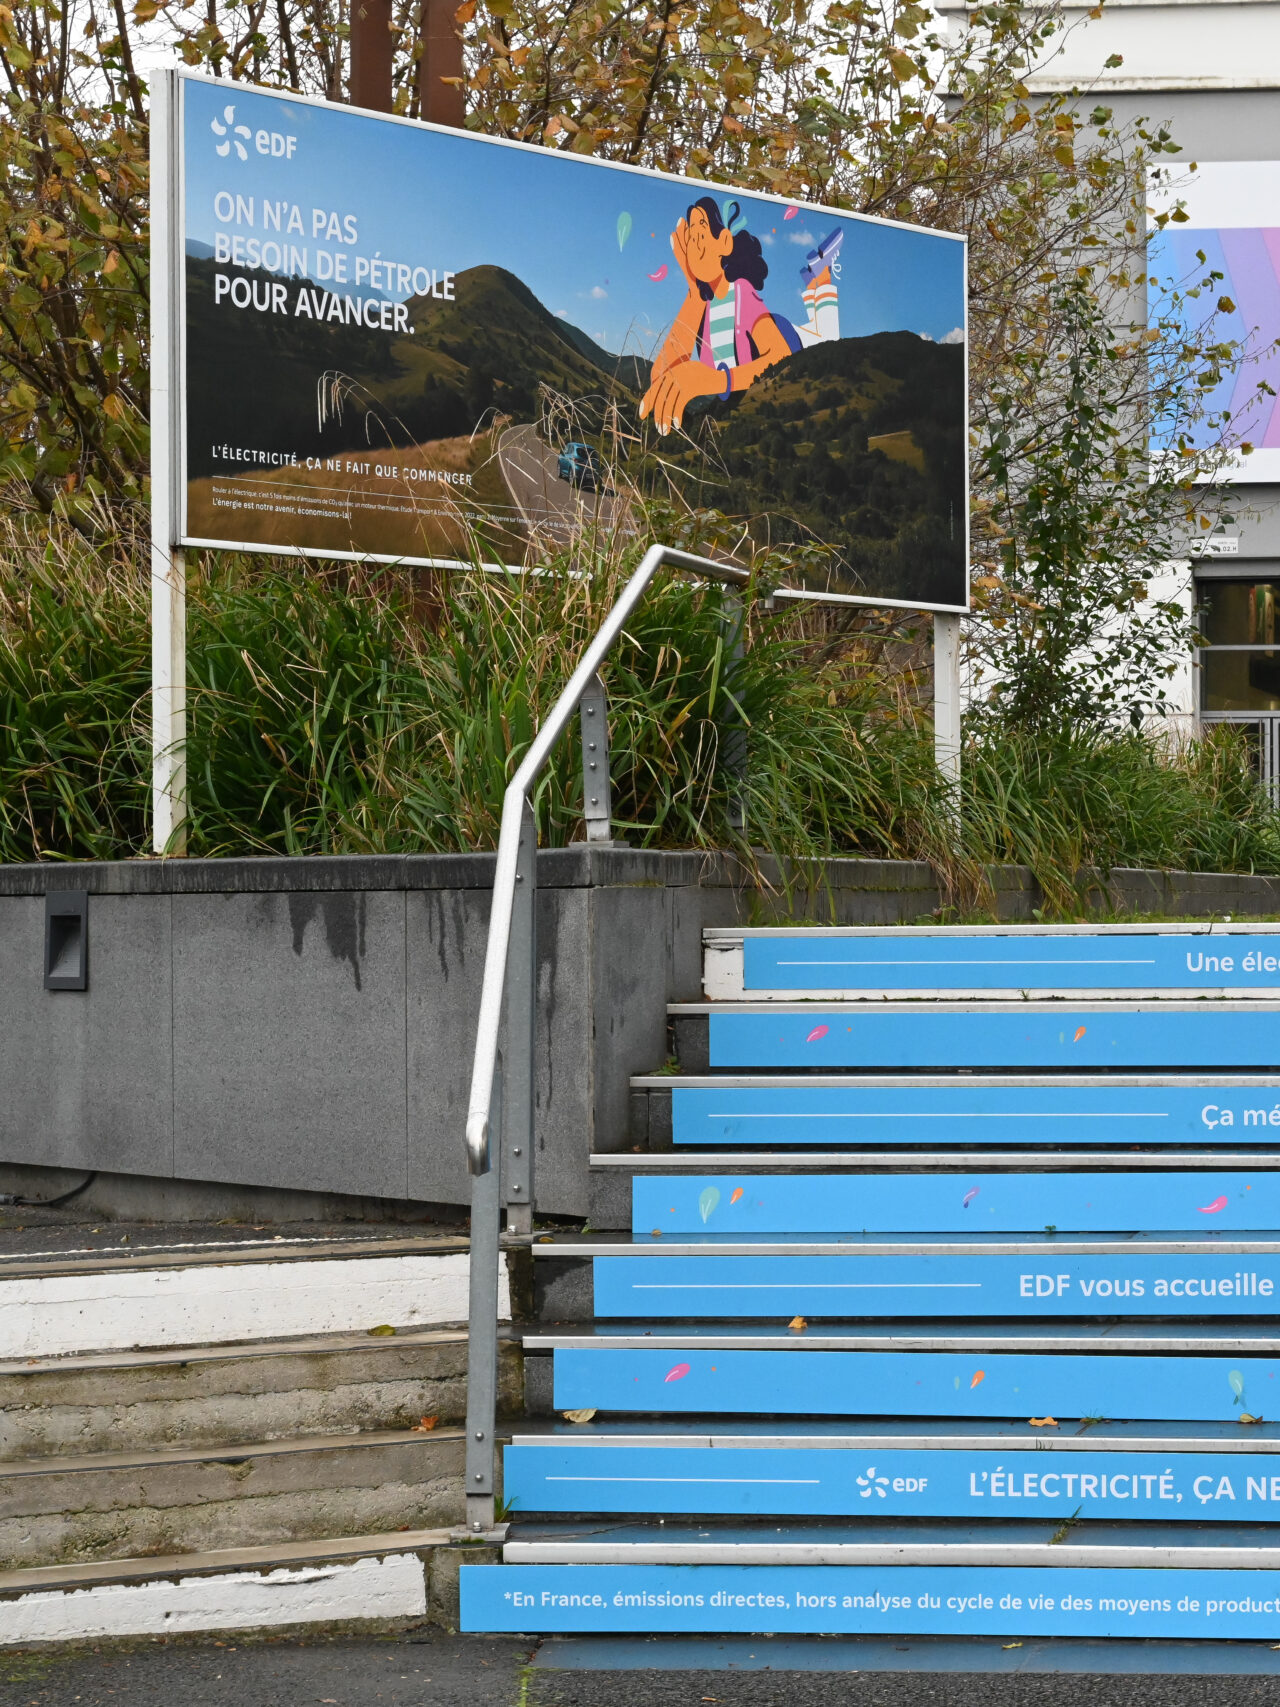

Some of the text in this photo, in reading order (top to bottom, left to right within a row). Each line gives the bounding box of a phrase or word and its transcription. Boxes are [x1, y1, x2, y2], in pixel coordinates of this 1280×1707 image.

[214, 191, 358, 246] ON N'A PAS
[214, 232, 456, 301] BESOIN DE PÉTROLE
[214, 273, 416, 335] POUR AVANCER.
[212, 445, 473, 486] L'ÉLECTRICITÉ, ÇA NE FAIT QUE COMMENCER
[212, 497, 242, 511] L'énergie
[243, 501, 255, 510] est
[255, 503, 274, 513] notre
[274, 505, 296, 515] avenir,
[1186, 952, 1234, 972] Une
[1201, 1105, 1234, 1130] Ça
[1019, 1274, 1071, 1297] EDF
[1079, 1279, 1145, 1297] vous
[1153, 1273, 1274, 1297] accueille
[970, 1466, 1183, 1503] L'ÉLECTRICITÉ,
[1193, 1475, 1236, 1505] ÇA
[541, 1591, 608, 1609] France,
[613, 1590, 705, 1608] émissions
[709, 1590, 790, 1609] directes,
[796, 1591, 837, 1608] hors
[842, 1592, 912, 1613] analyse
[917, 1592, 941, 1609] du
[946, 1593, 994, 1613] cycle
[999, 1593, 1022, 1610] de
[1027, 1593, 1055, 1611] vie
[1060, 1594, 1093, 1611] des
[1099, 1598, 1172, 1616] moyens
[1176, 1595, 1201, 1612] de
